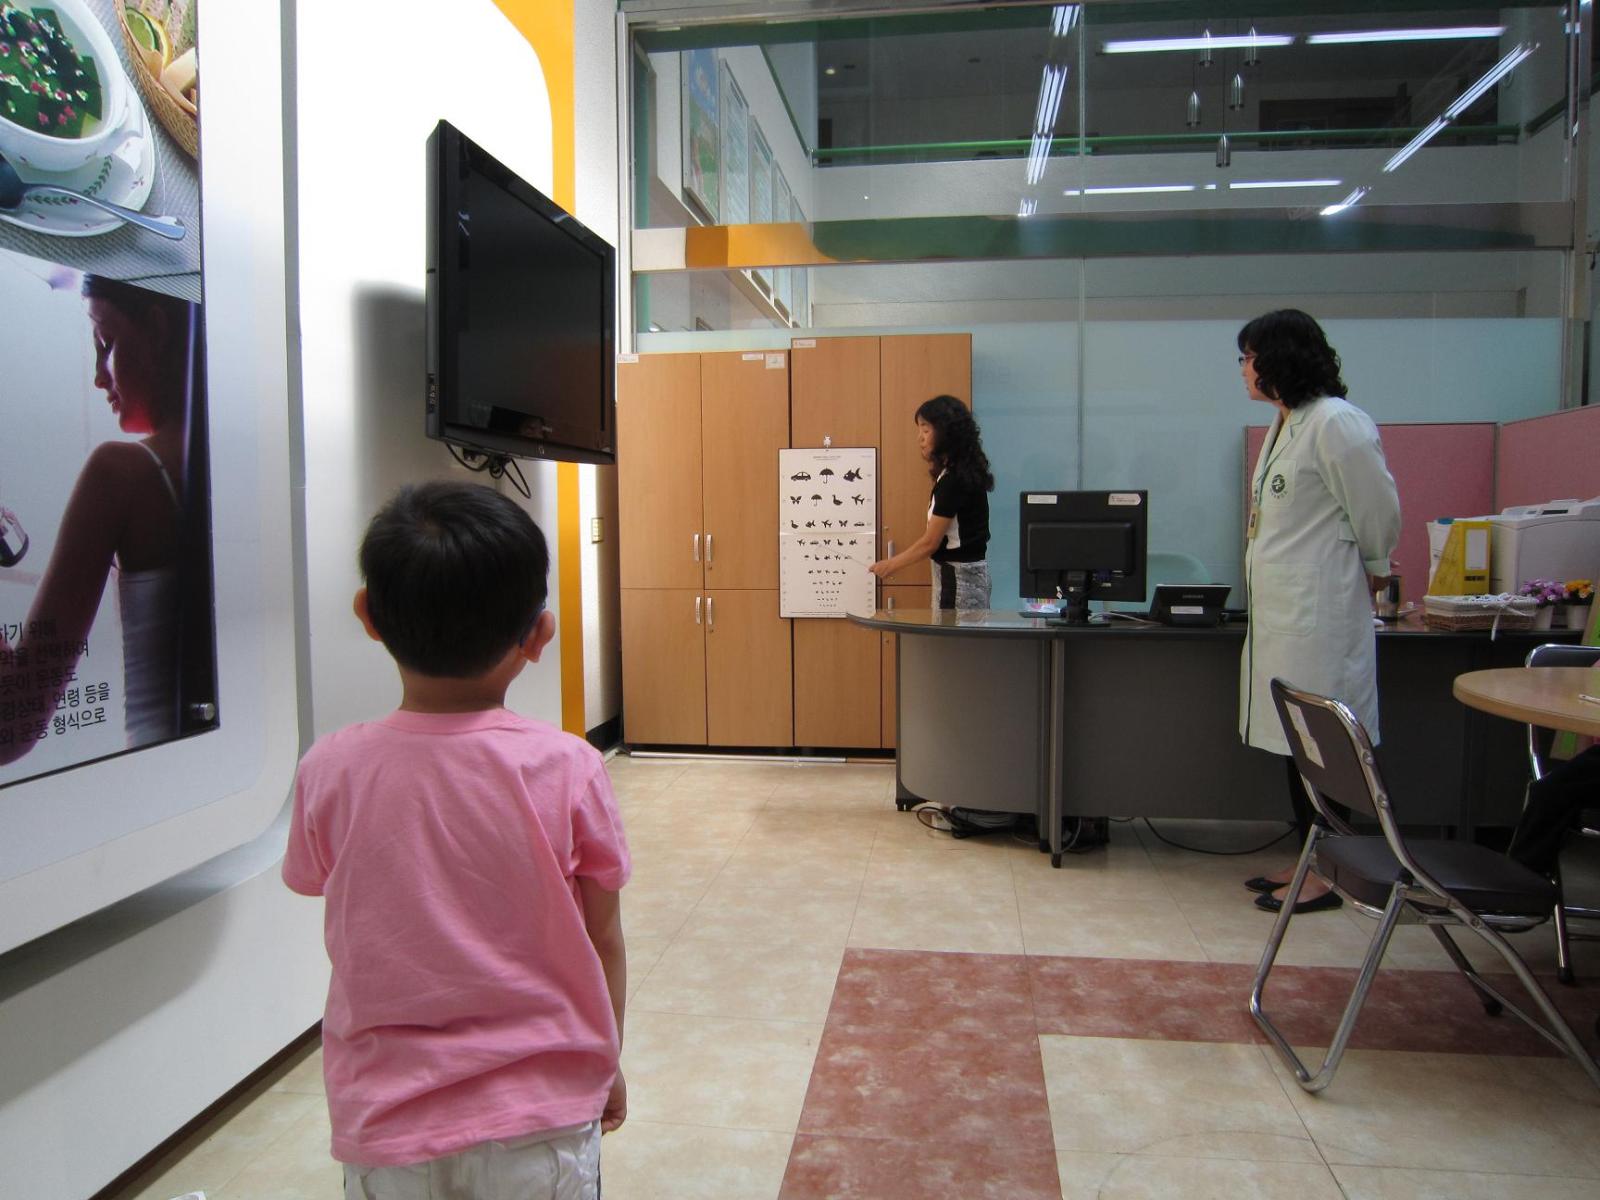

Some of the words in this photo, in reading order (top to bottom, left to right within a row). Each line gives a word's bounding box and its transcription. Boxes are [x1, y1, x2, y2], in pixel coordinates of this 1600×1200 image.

[53, 688, 80, 710] 연령
[85, 682, 110, 704] 등을
[53, 707, 107, 735] 형식으로
